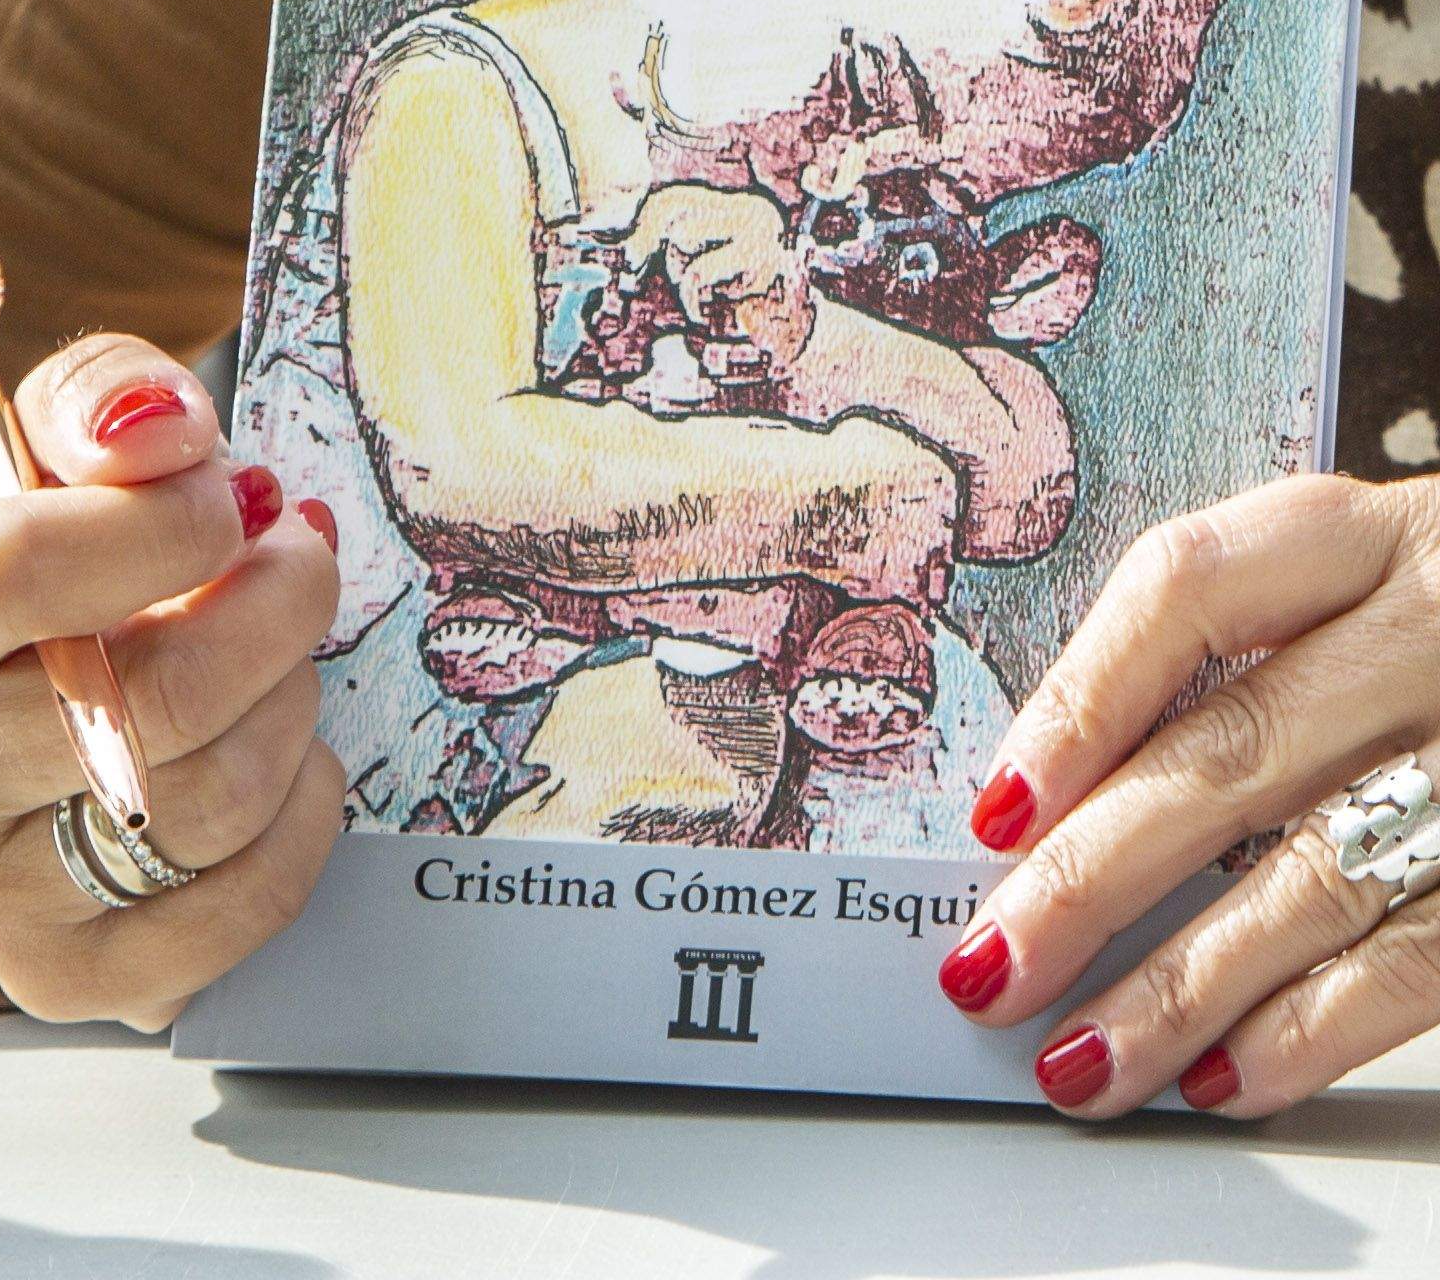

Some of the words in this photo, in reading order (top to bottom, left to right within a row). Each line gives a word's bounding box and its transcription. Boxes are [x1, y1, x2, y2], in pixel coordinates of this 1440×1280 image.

[414, 858, 617, 910] Cristina
[634, 869, 817, 919] Gómez
[834, 877, 984, 939] Esqui
